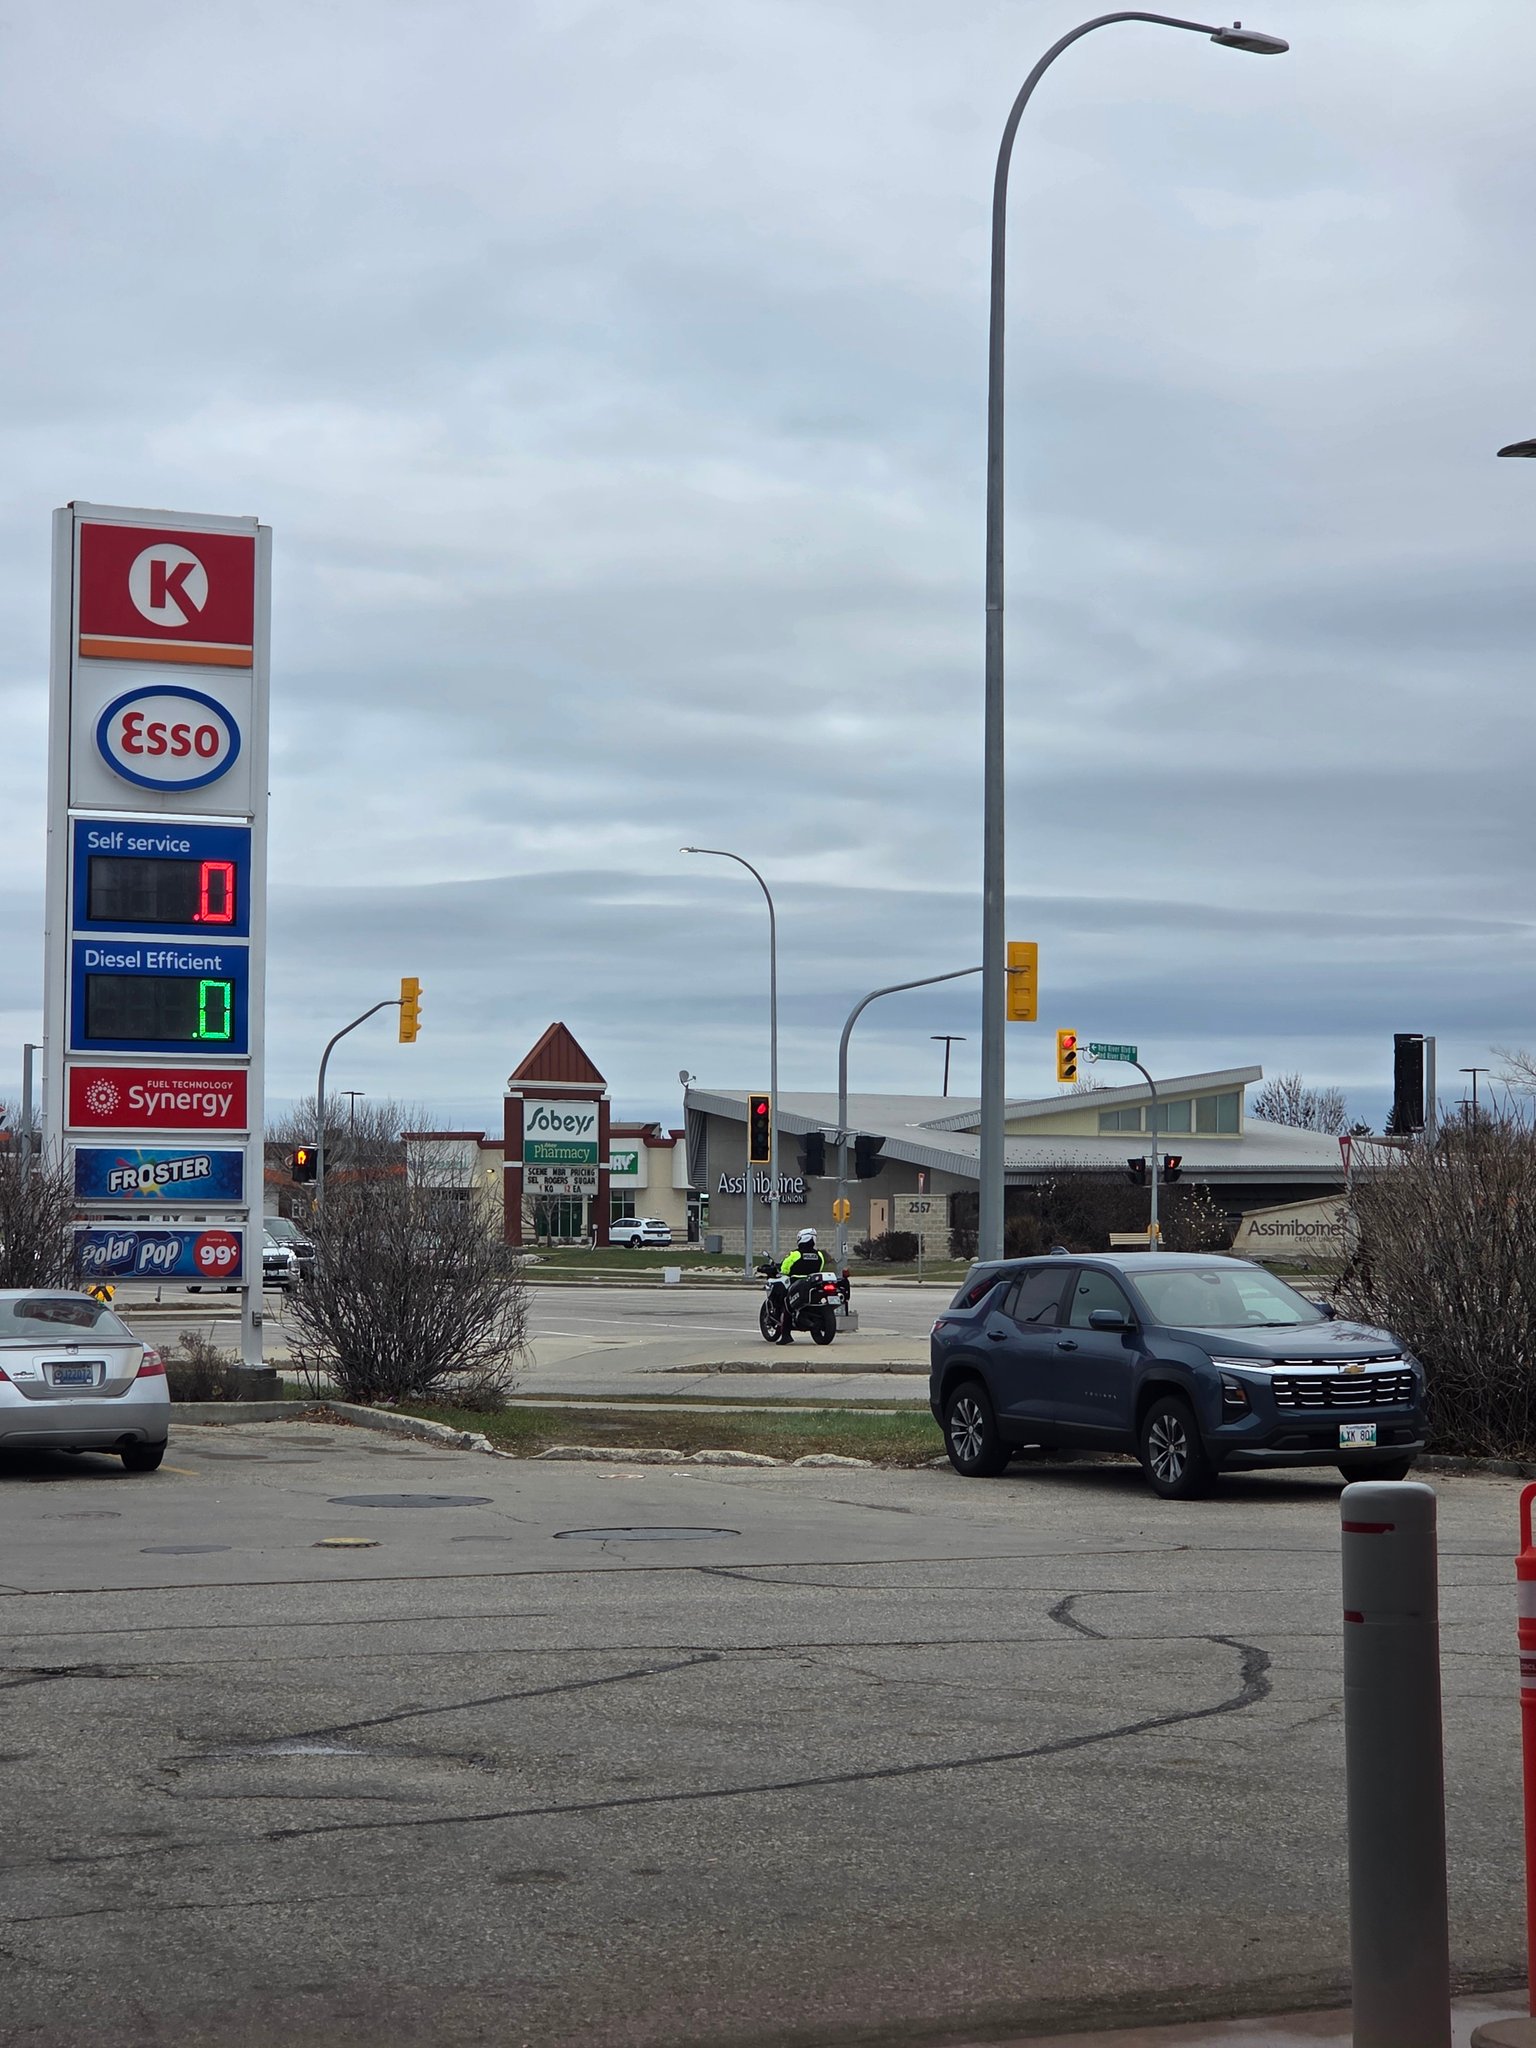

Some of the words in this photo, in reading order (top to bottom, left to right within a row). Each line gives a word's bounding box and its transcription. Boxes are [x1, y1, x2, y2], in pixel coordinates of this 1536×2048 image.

[149, 559, 201, 624] K
[121, 711, 219, 758] Esso
[87, 831, 124, 850] Self
[127, 834, 190, 853] service
[84, 949, 141, 969] Diesel
[146, 951, 222, 971] Efficient
[147, 1080, 170, 1089] FUEL
[172, 1081, 233, 1090] TECHNOLOGY
[128, 1085, 233, 1118] Synergy
[526, 1106, 595, 1136] Sobeys
[533, 1144, 590, 1163] Pharmacy
[110, 1157, 210, 1191] FROSTER
[570, 1168, 596, 1177] PRICING
[573, 1177, 596, 1185] SUGAR
[717, 1171, 804, 1194] Assiibine
[1247, 1219, 1343, 1236] Assiniboine
[139, 1241, 179, 1269] Pop
